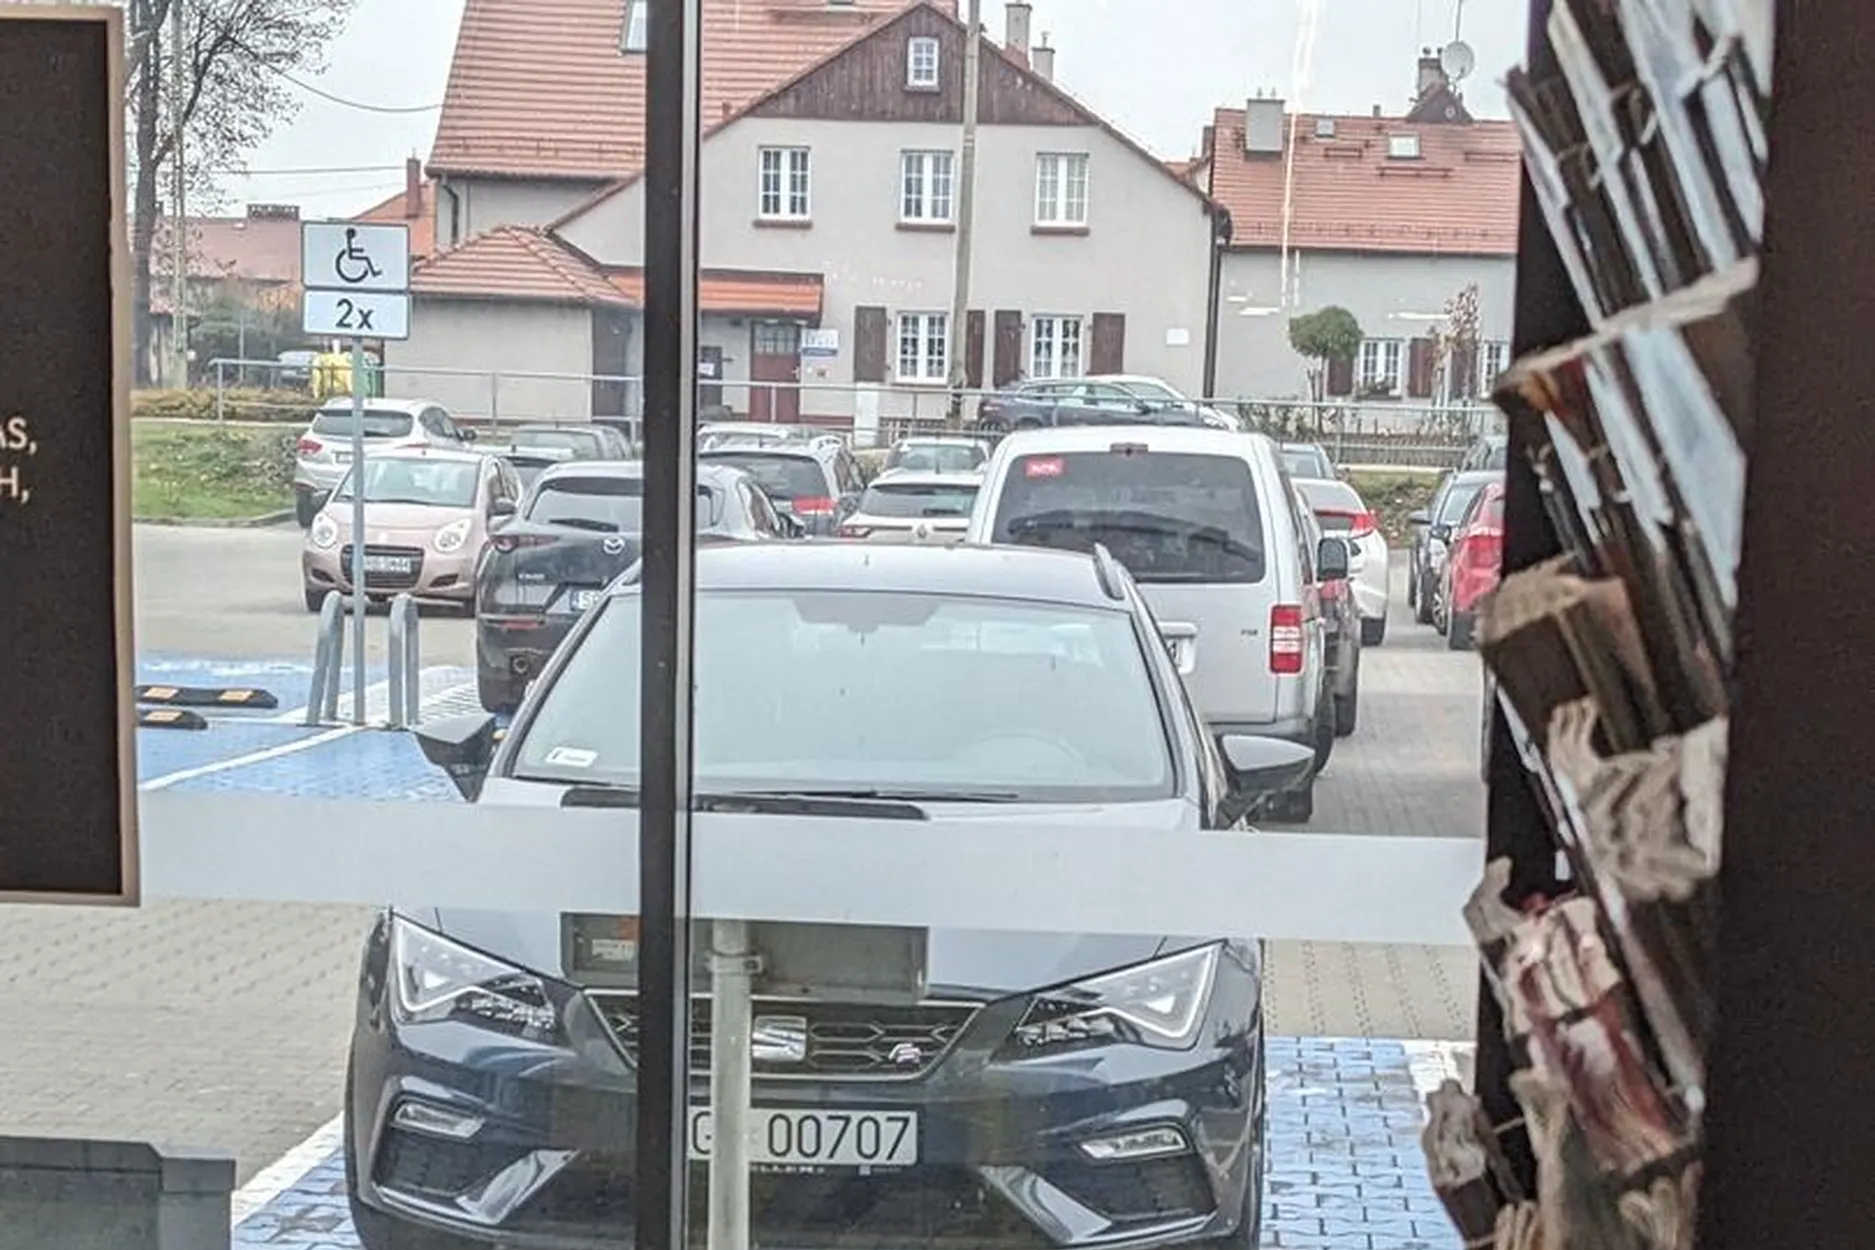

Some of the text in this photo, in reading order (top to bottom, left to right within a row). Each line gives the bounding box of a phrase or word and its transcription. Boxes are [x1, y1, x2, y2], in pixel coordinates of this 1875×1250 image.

[336, 298, 374, 330] 2x
[0, 417, 37, 455] S,
[767, 1112, 911, 1161] 00707
